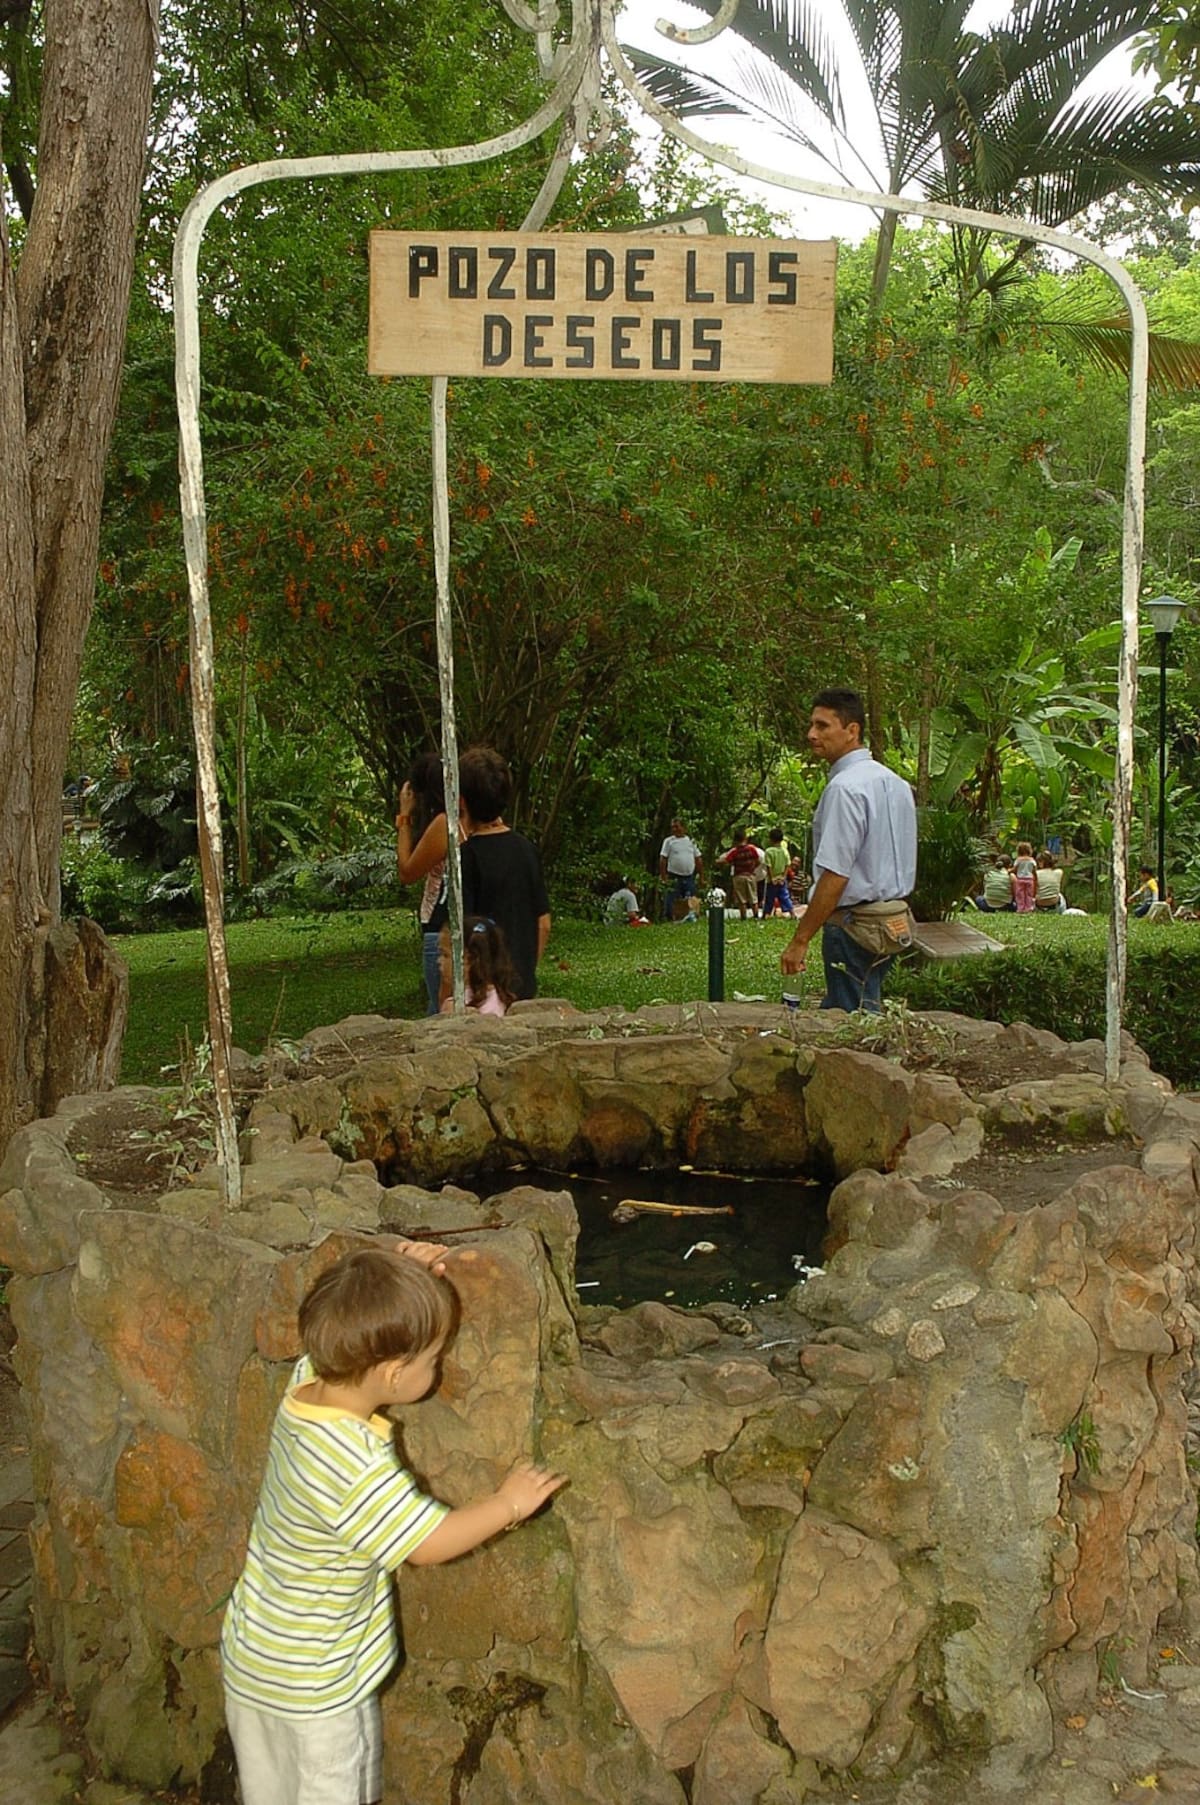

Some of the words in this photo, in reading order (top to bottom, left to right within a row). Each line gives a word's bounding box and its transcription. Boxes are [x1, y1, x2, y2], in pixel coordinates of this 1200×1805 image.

[408, 245, 556, 301] POZO
[585, 248, 655, 302] DE
[685, 250, 799, 305] LOS
[482, 314, 723, 372] DESEOS
